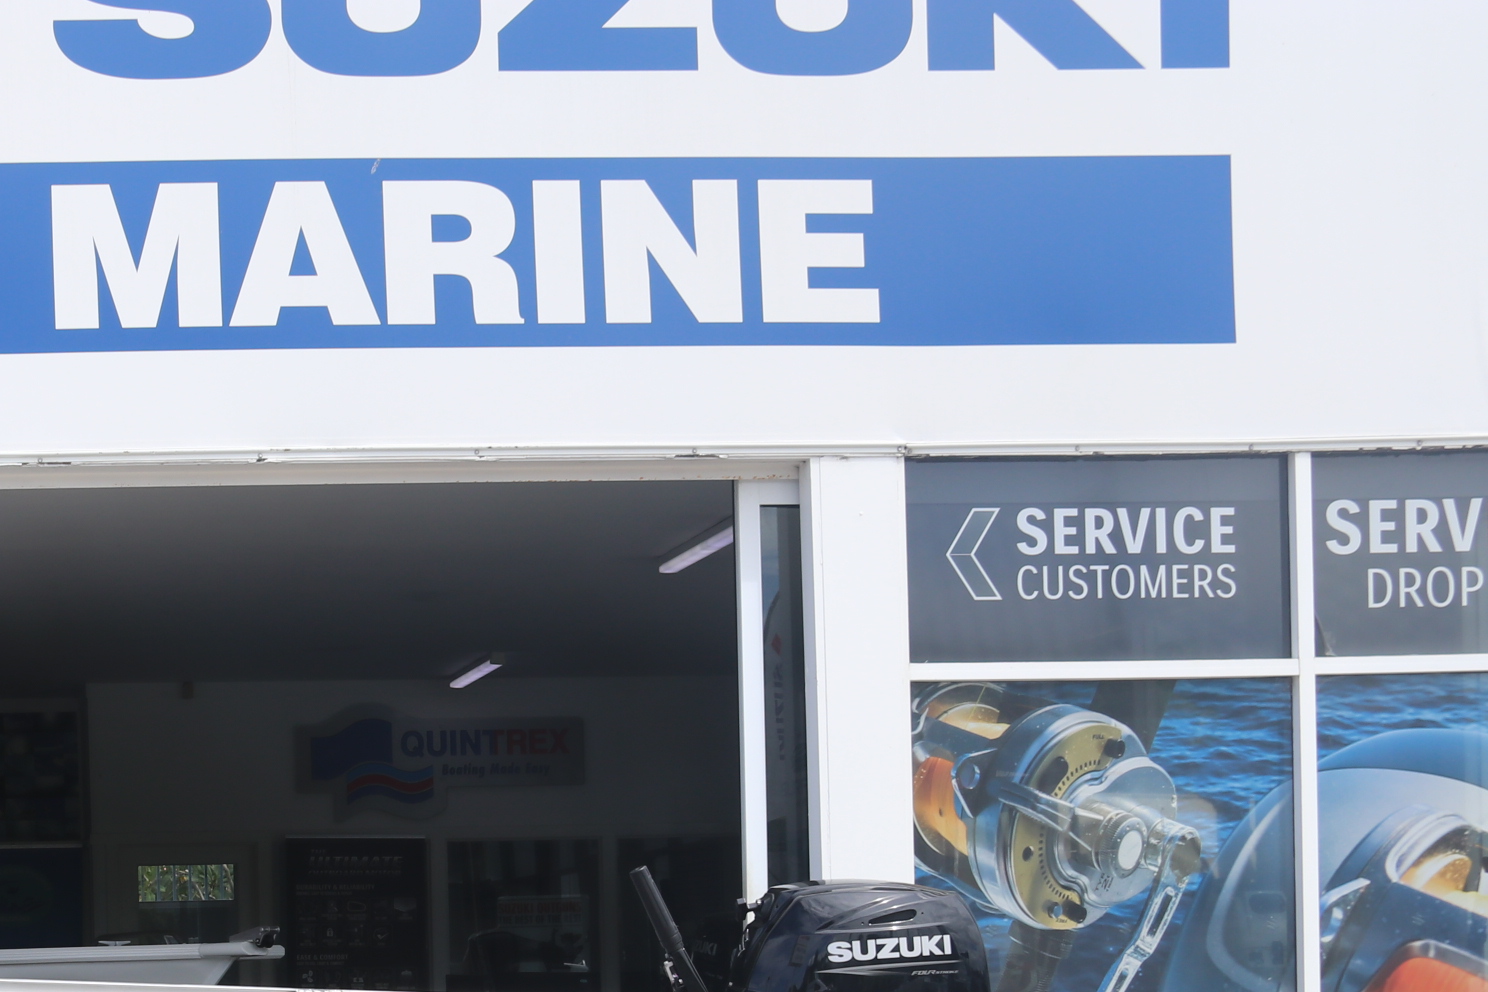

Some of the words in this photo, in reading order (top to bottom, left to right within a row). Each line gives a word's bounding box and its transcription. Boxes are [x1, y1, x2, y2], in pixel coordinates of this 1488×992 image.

[51, 179, 881, 330] MARINE
[1016, 506, 1237, 556] SERVICE
[1325, 497, 1484, 555] SERV
[1016, 564, 1237, 601] CUSTOMERS
[1367, 565, 1485, 609] DROP
[400, 728, 571, 758] QUINTREX
[826, 934, 952, 963] SUZUKI
